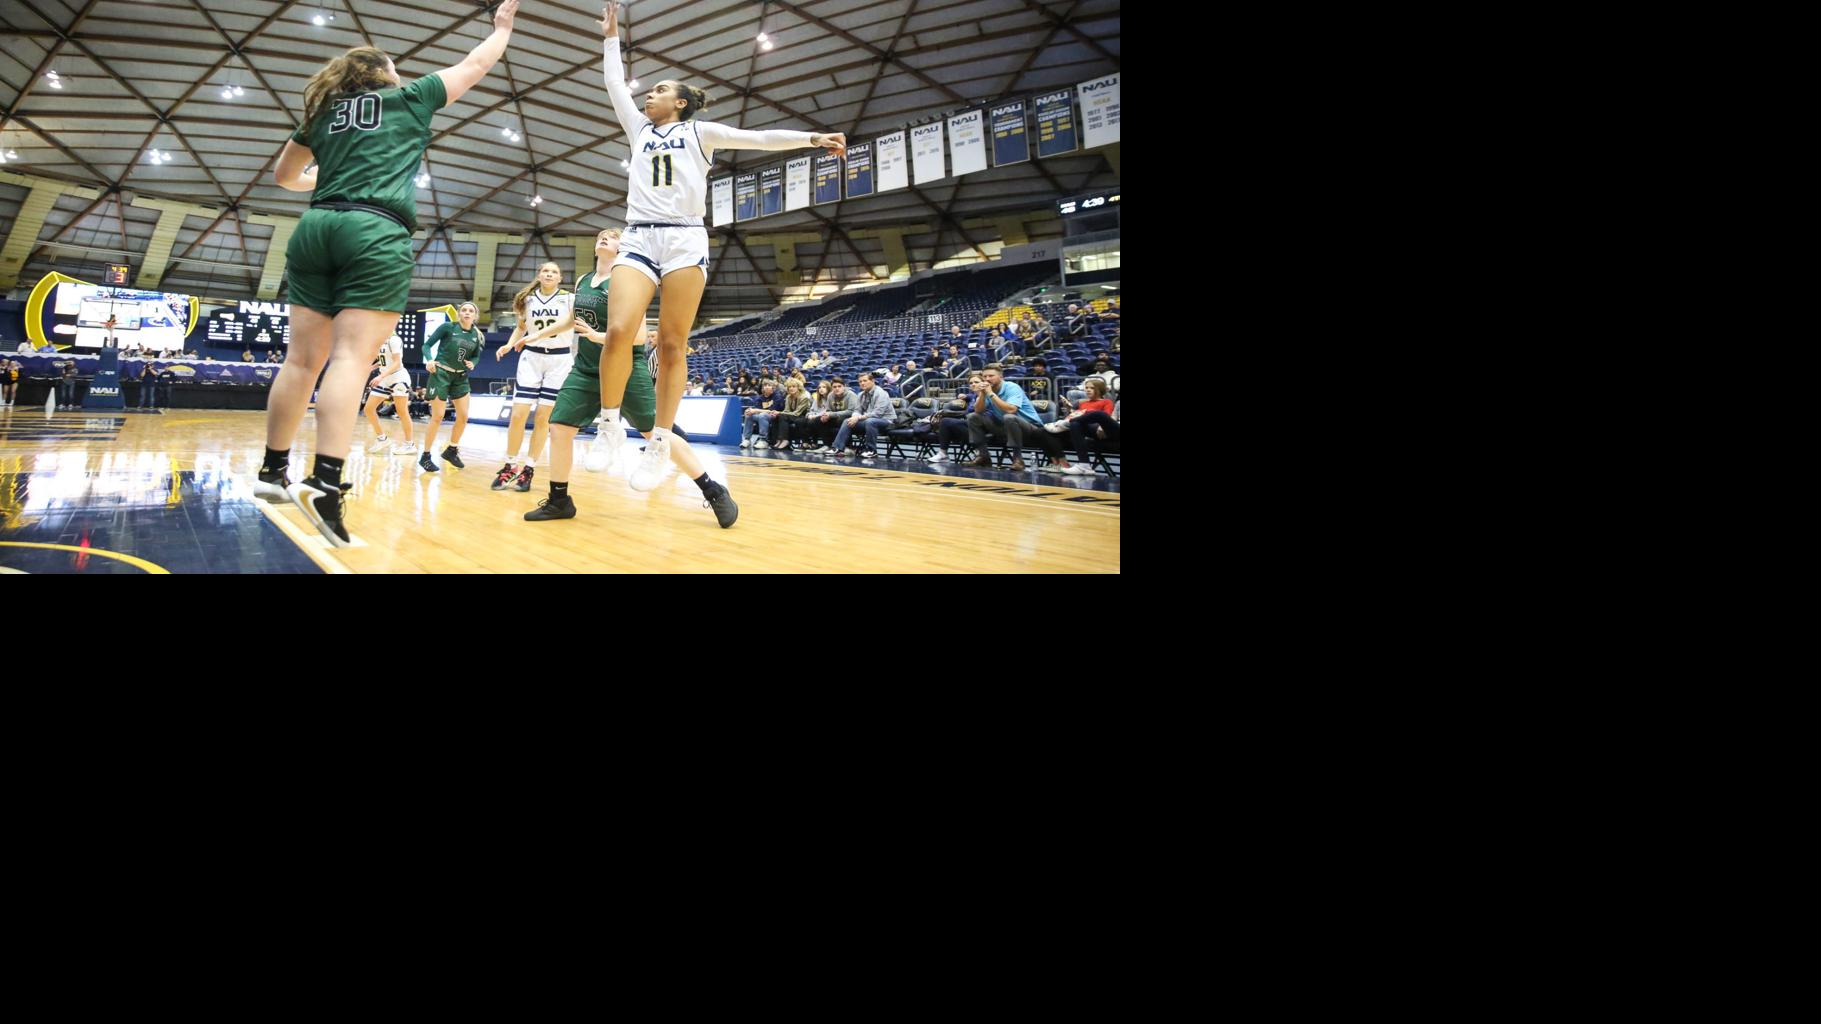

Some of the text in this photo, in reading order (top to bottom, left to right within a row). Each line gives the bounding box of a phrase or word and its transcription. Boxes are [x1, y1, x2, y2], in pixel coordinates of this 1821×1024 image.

[1082, 78, 1117, 93] NAU
[1036, 91, 1069, 106] NAU
[328, 92, 383, 135] 30
[992, 104, 1022, 116] NAU
[951, 114, 978, 127] NAU
[914, 125, 939, 136] NAU
[643, 137, 686, 153] NAU
[879, 135, 901, 146] NAU
[847, 144, 869, 156] NAU
[788, 160, 807, 169] NAU
[816, 154, 837, 164] NAU
[651, 153, 673, 187] 11
[762, 167, 780, 177] NAU
[714, 180, 730, 188] NAU
[737, 174, 755, 183] NAU
[240, 300, 290, 317] NAU
[531, 308, 559, 318] NAU
[929, 315, 942, 323] 113
[90, 387, 119, 395] NAU
